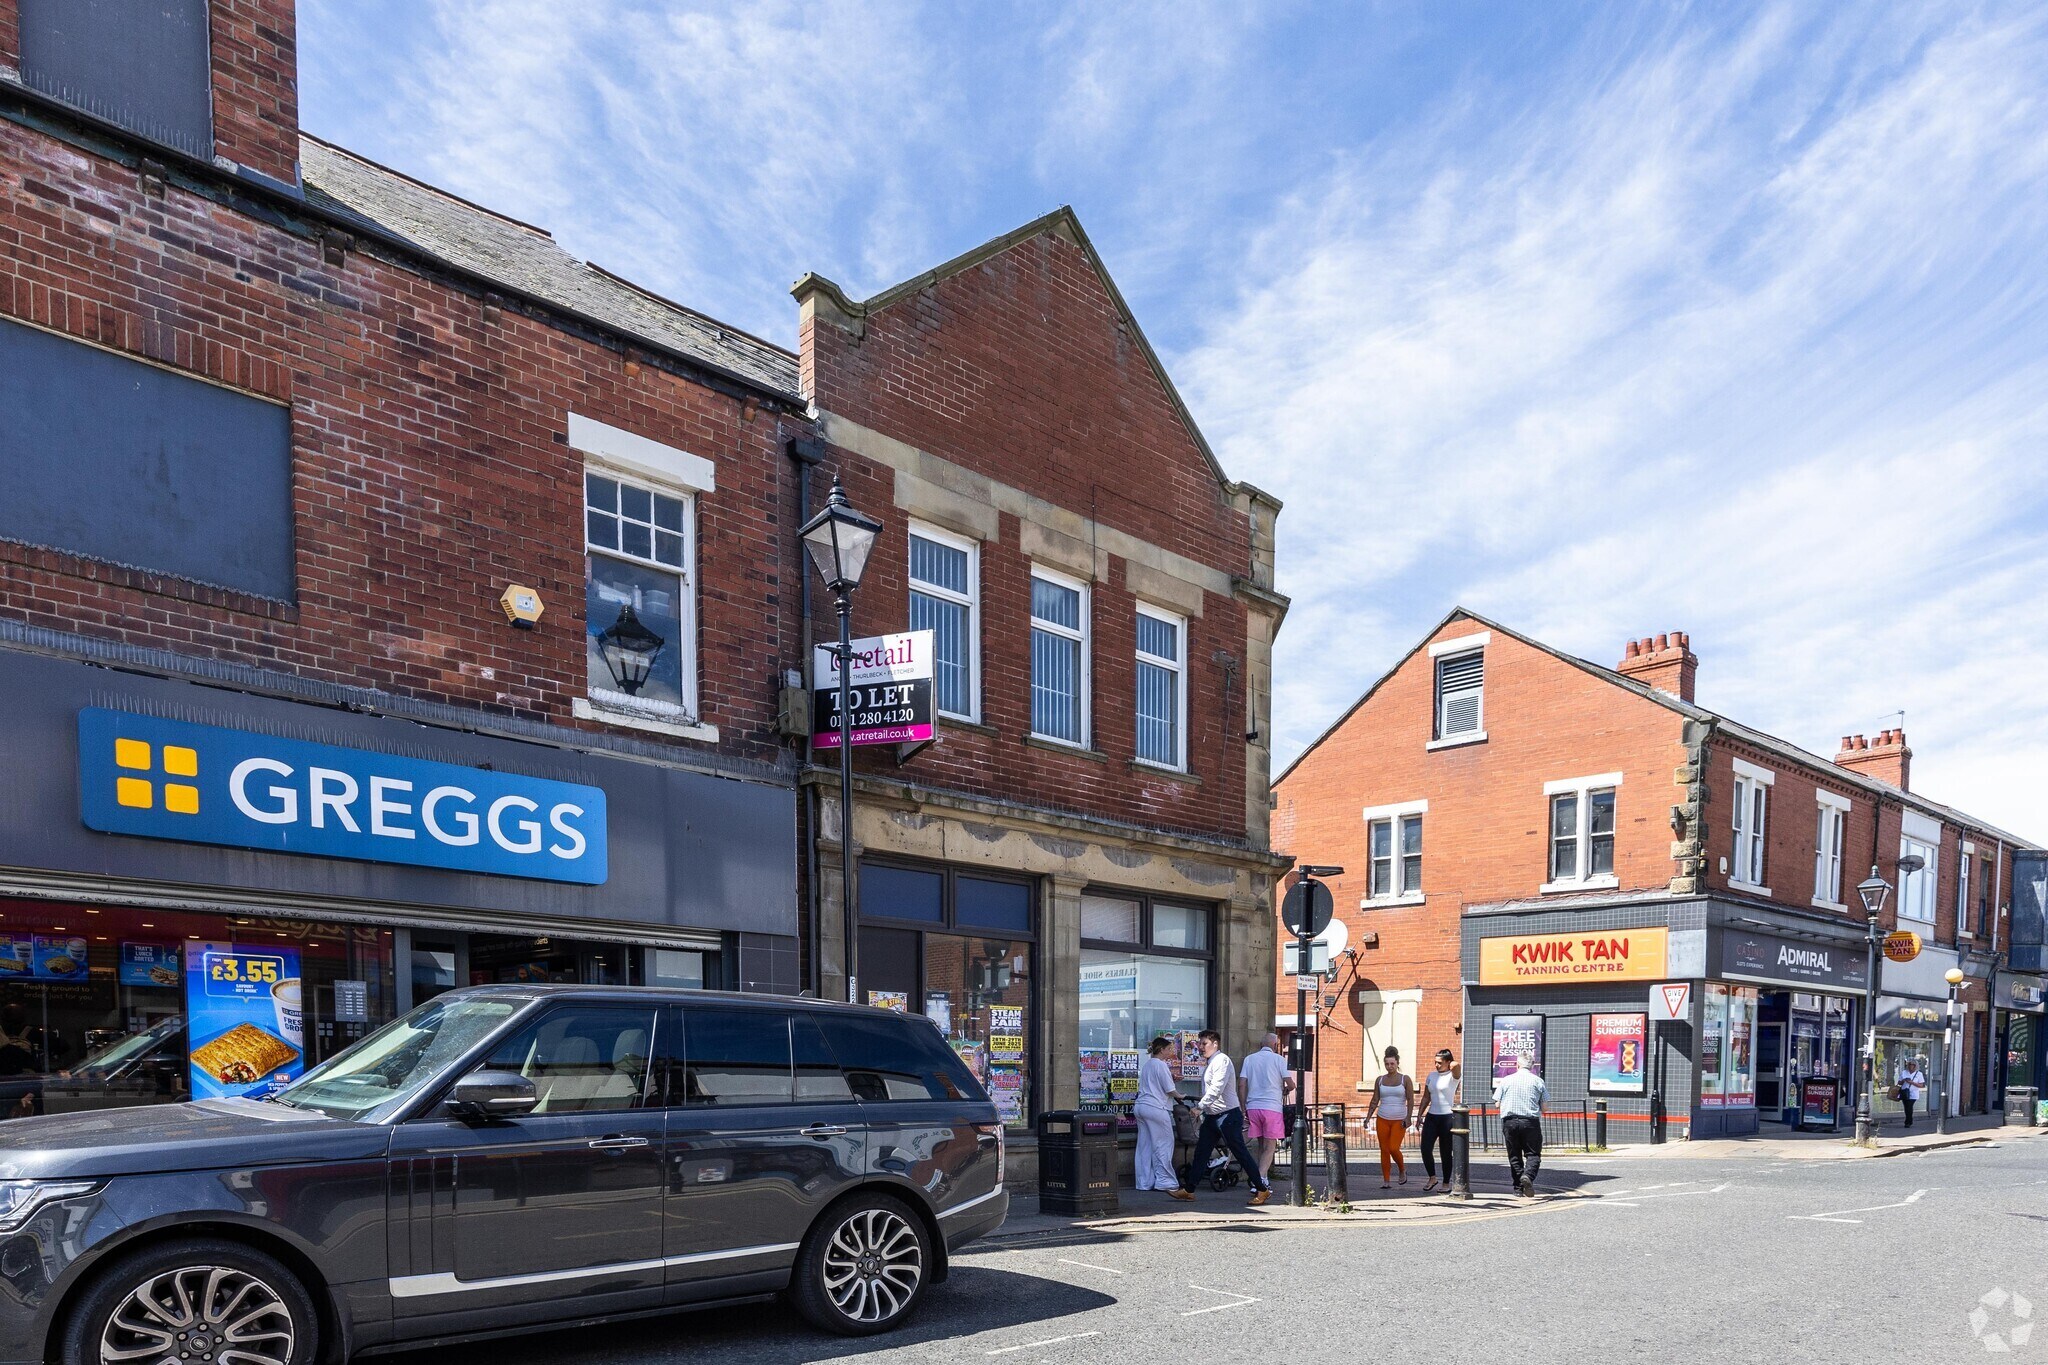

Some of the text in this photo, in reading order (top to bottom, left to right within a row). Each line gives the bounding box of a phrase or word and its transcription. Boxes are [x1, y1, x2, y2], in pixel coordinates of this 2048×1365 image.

[853, 667, 914, 680] THURLBECK FLETCHER
[868, 684, 914, 708] LET
[830, 708, 914, 728] 011 280 4120
[229, 757, 586, 860] GREGGS
[1889, 939, 1914, 949] KWIK
[1512, 938, 1629, 965] KWIK TAN
[1736, 944, 1765, 959] CASINO
[1890, 947, 1911, 956] TAN
[1777, 945, 1832, 972] ADMIRAL
[211, 959, 277, 984] £3.55
[1516, 963, 1624, 976] TANNING CENTRE
[1668, 989, 1681, 997] GIVE
[991, 1009, 1022, 1018] STEAM
[991, 1019, 1022, 1027] FAIR
[1596, 1019, 1642, 1027] PREMIUM
[1500, 1030, 1536, 1042] FREE
[1595, 1027, 1642, 1035] SUNBEDS
[1703, 1029, 1719, 1040] FREE
[1500, 1041, 1536, 1049] SUNBED
[1499, 1049, 1535, 1057] SESSION
[1103, 1104, 1118, 1114] 280
[1088, 1181, 1110, 1189] LITTER
